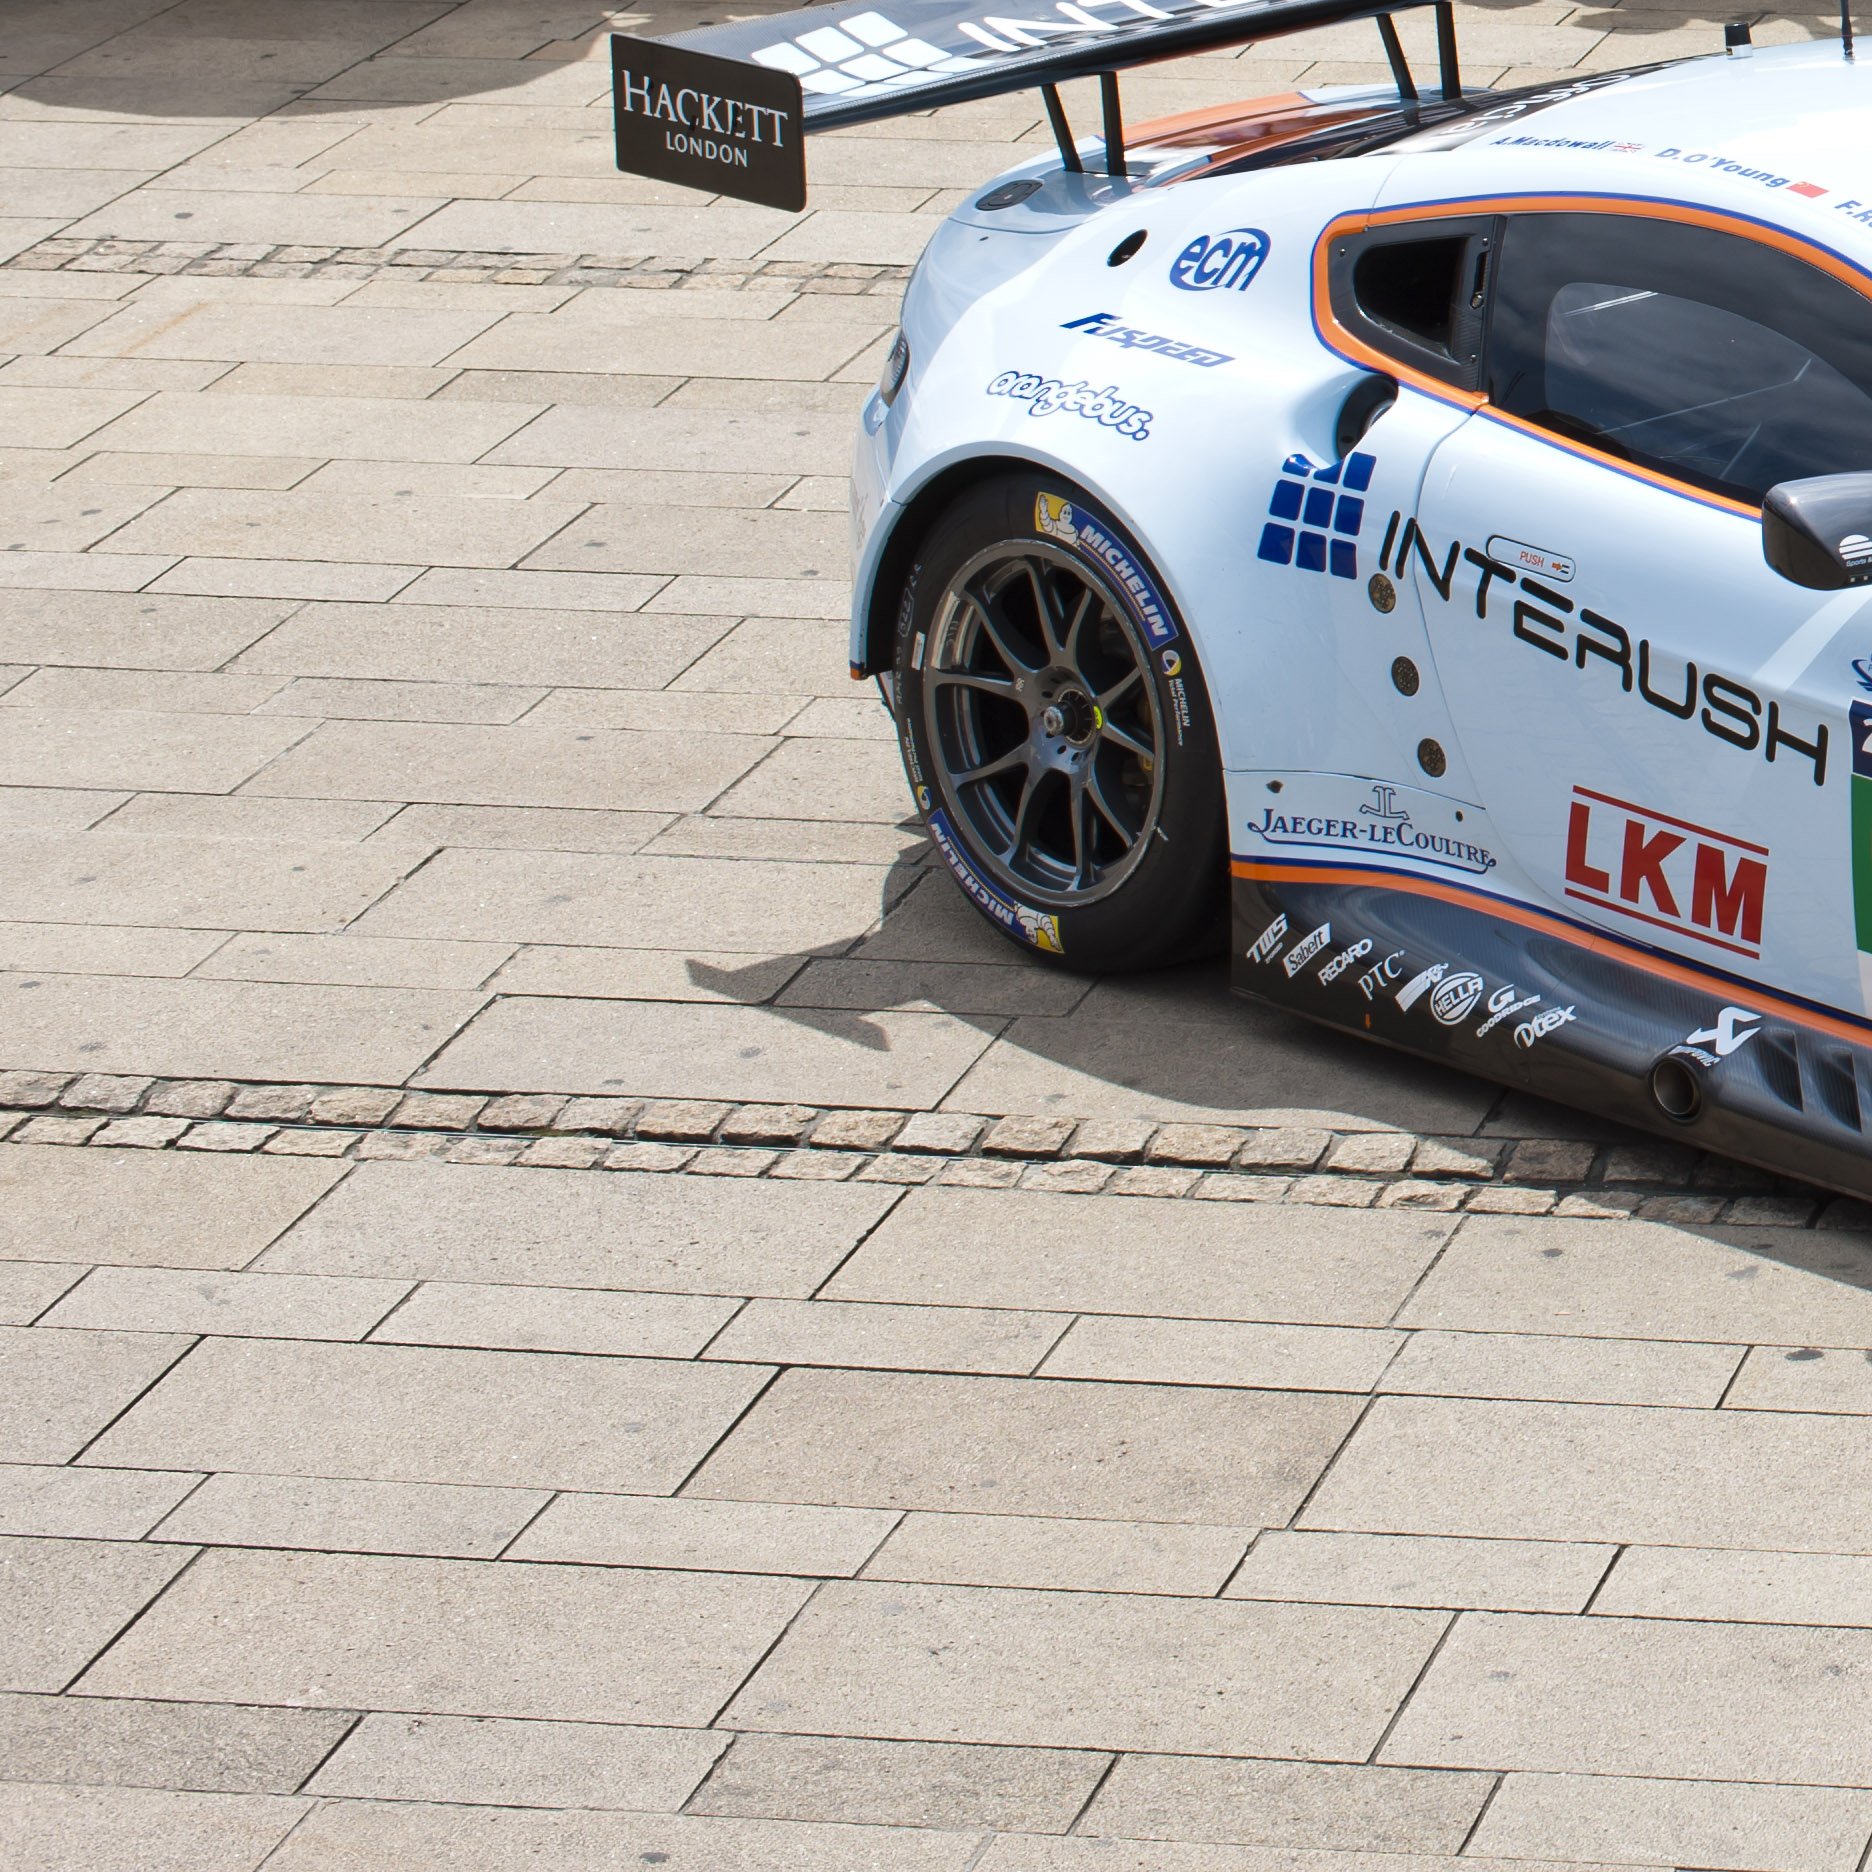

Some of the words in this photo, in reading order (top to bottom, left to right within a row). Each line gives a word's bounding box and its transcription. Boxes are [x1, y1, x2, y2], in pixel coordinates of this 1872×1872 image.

[620, 69, 789, 147] HACKETT
[665, 131, 749, 169] LONDON
[1168, 227, 1272, 292] ecm
[1078, 523, 1171, 639] MICHELIN
[1519, 548, 1546, 570] PUSH
[1379, 509, 1830, 786] INTERUSH
[931, 822, 1015, 927] MICHELIN
[1565, 801, 1770, 946] LKM
[1289, 929, 1327, 973] Sabelt
[1317, 937, 1374, 987] RECARO
[1433, 978, 1485, 1019] HELLA
[1476, 993, 1543, 1040] GOODRIDGE
